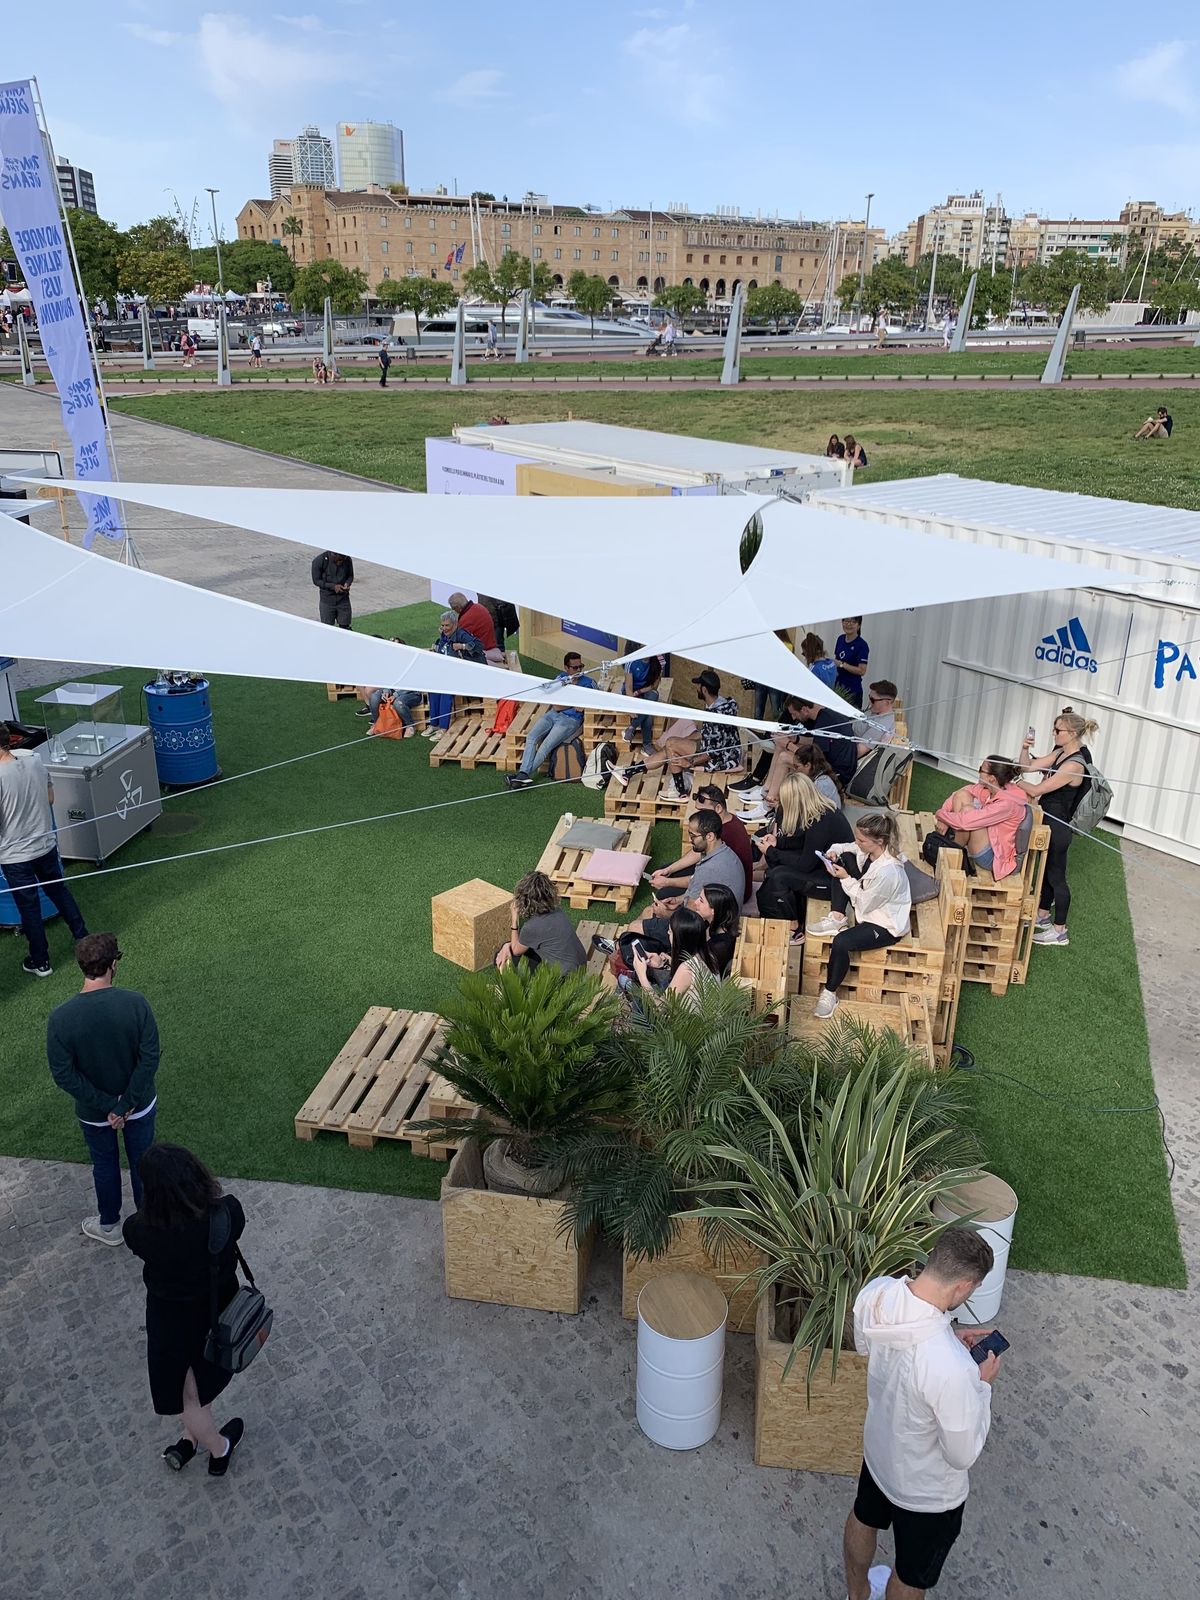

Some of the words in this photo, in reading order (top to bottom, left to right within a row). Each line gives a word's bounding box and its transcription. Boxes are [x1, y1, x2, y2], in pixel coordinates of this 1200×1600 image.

[702, 231, 738, 247] Museu
[1034, 645, 1098, 674] adidas
[1154, 639, 1200, 689] PA
